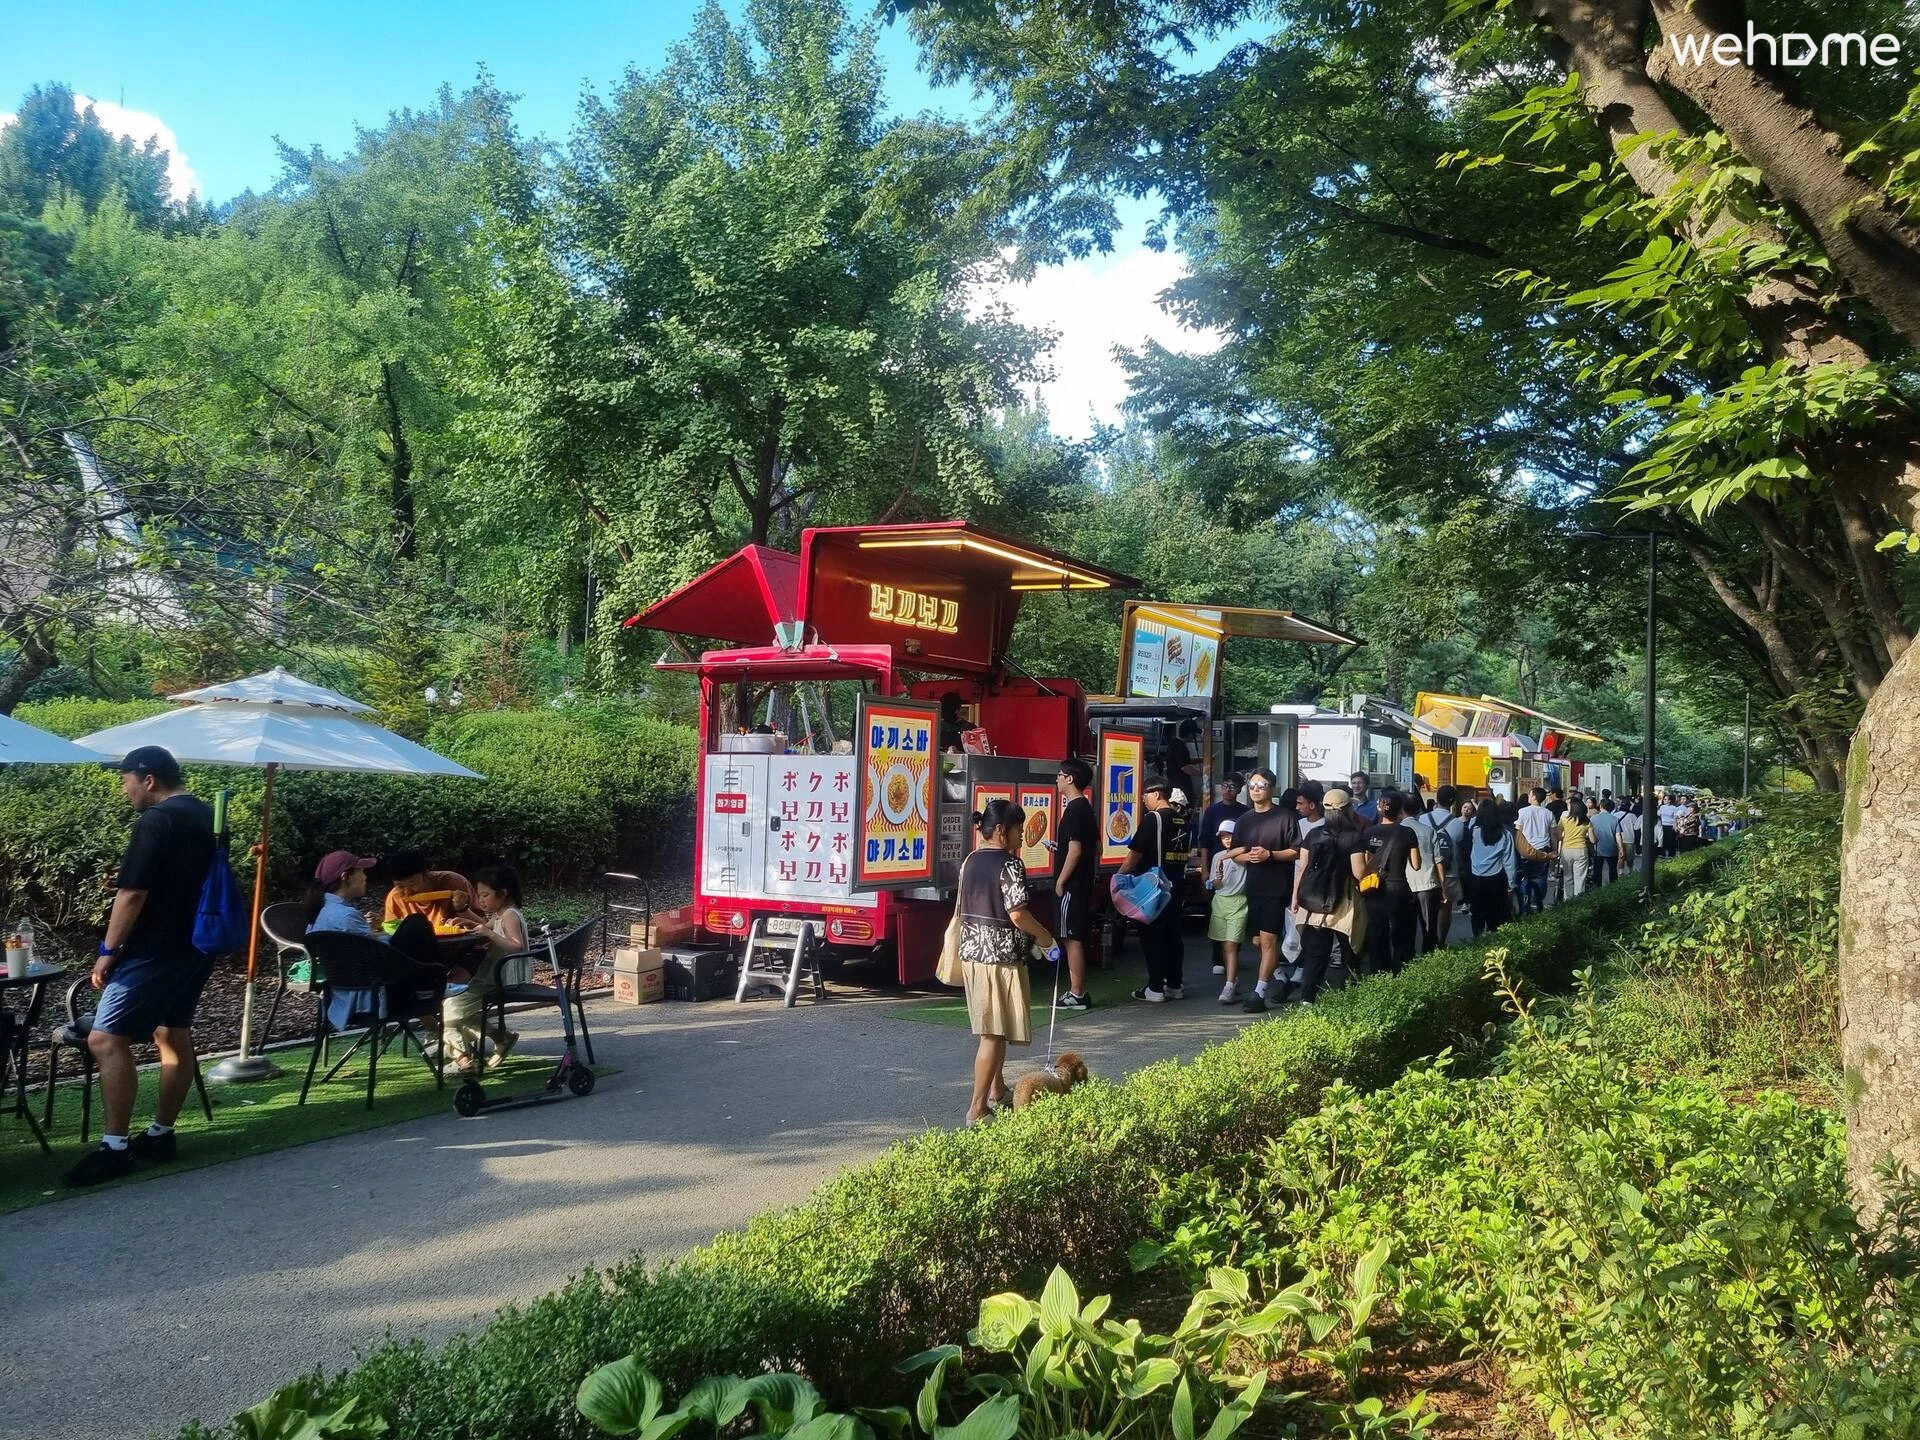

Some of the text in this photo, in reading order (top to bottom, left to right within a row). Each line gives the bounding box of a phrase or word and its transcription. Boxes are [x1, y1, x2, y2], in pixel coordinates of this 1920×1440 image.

[871, 725, 929, 752] 야끼소바
[781, 771, 851, 793] ボクボ
[716, 798, 745, 809] 화기엄금
[942, 816, 961, 824] ORDER
[780, 831, 850, 854] ボクボ
[866, 837, 925, 863] 야끼소바
[941, 843, 961, 851] PICK UP
[941, 851, 961, 859] HERE
